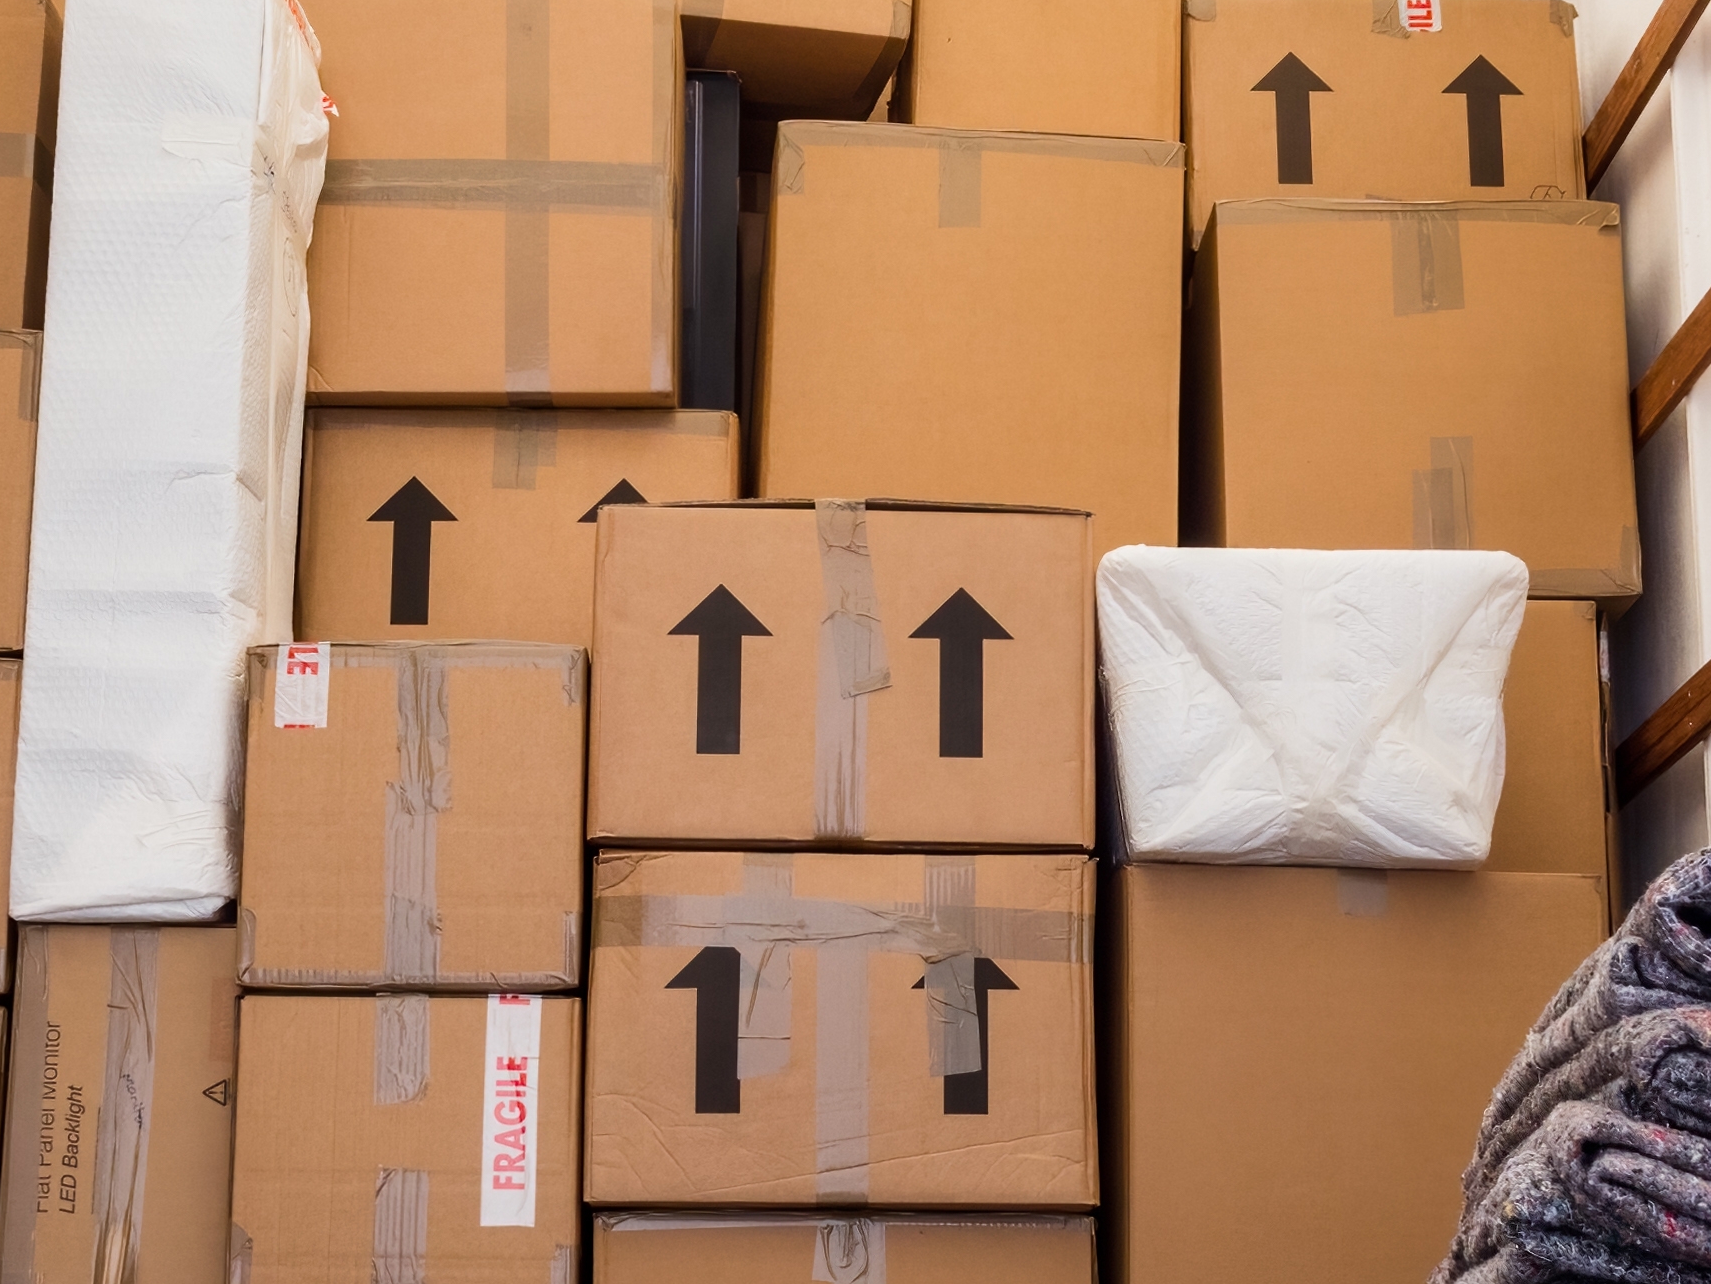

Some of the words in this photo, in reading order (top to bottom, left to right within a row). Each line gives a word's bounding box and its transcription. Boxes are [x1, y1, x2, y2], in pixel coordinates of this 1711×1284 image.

[42, 1020, 61, 1100] Monitor
[62, 1084, 86, 1169] Backlight
[492, 1056, 528, 1190] FRAGILE
[59, 1174, 77, 1214] LED
